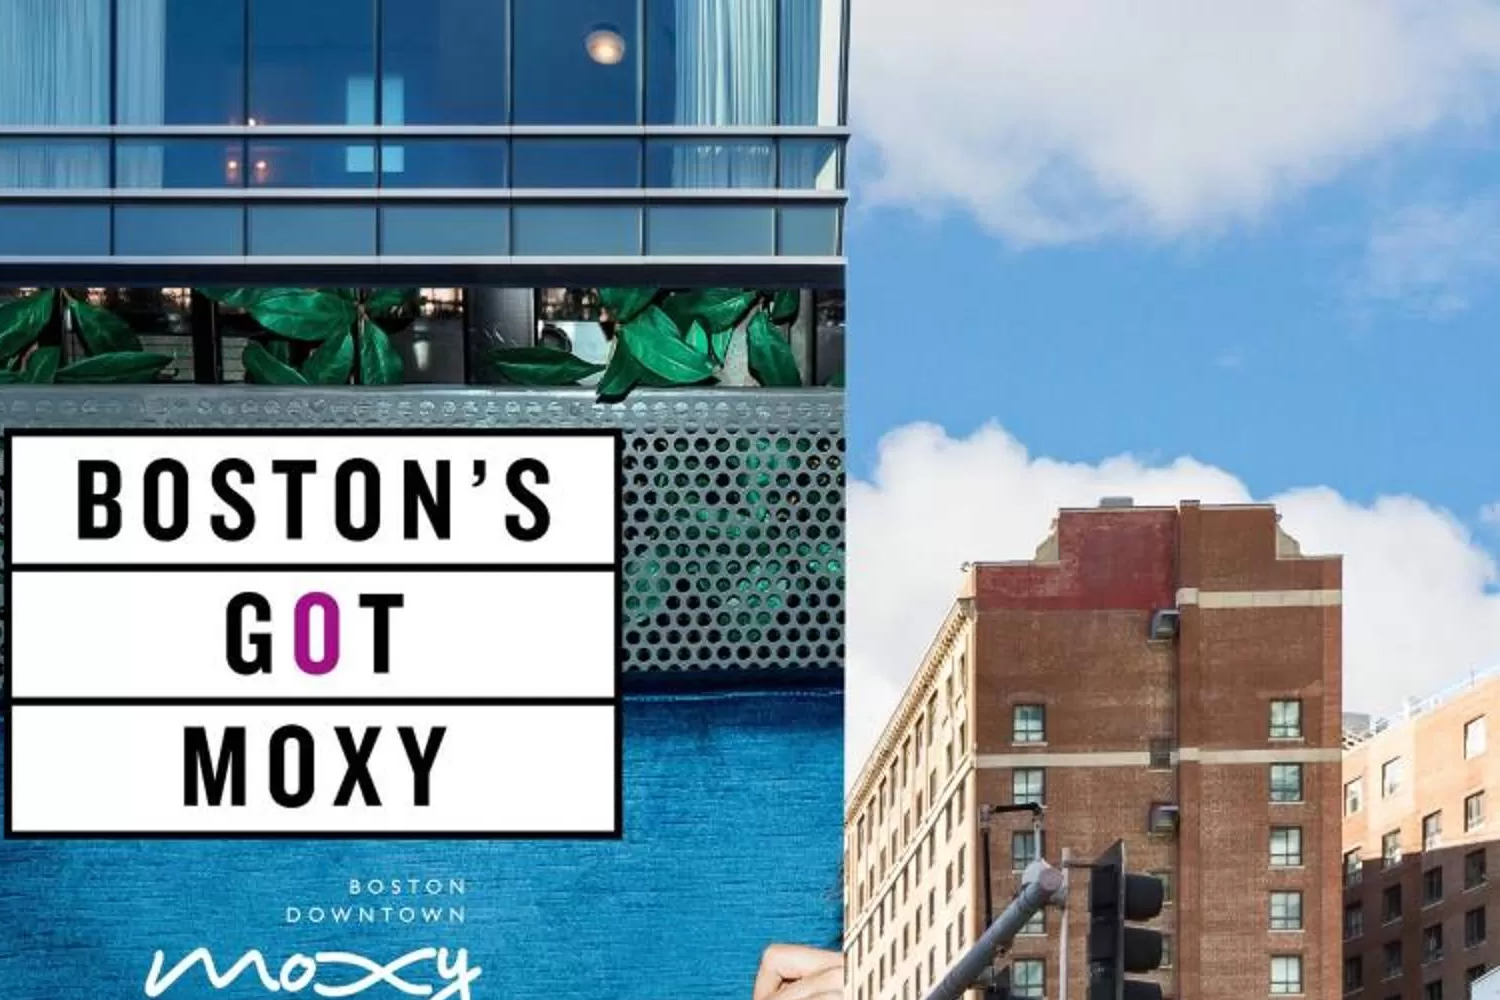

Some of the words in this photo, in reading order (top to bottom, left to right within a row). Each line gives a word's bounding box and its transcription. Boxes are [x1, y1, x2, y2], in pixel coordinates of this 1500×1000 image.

[78, 458, 550, 541] BOSTON'S
[226, 592, 404, 675] GOT
[184, 724, 446, 808] MOXY
[286, 907, 465, 923] DOWNTOWN
[348, 879, 465, 895] BOSTON
